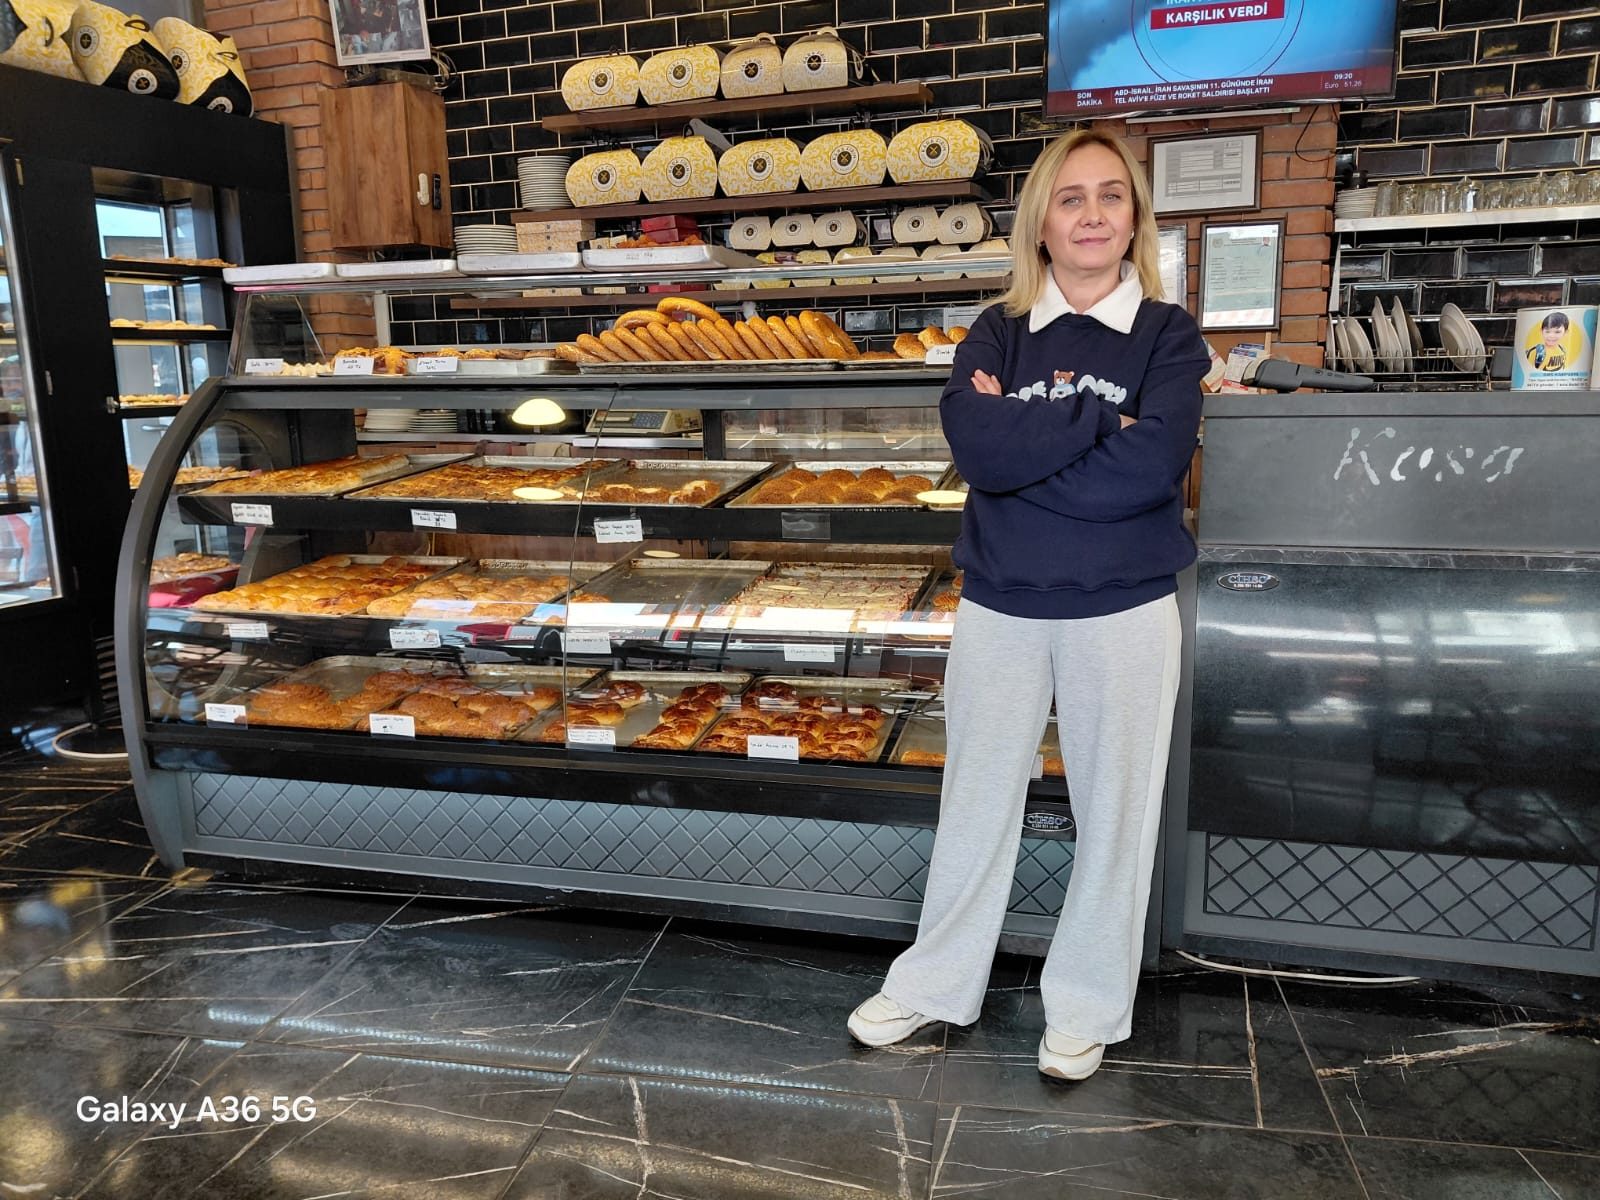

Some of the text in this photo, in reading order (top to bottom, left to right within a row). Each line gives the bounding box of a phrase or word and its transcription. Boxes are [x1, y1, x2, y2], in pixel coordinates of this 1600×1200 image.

[1166, 2, 1268, 24] KARŞILIK VERDİ
[1155, 84, 1172, 93] İRAN
[1172, 82, 1209, 92] SAVAŞININ
[1210, 82, 1220, 90] 11.
[1221, 79, 1256, 88] GÜNÜNDE
[1256, 77, 1273, 86] İRAN
[1077, 91, 1092, 100] SON
[1077, 98, 1103, 107] DAKİKA
[1115, 97, 1126, 105] TEL
[1150, 92, 1166, 102] FÜZE
[1168, 92, 1177, 100] VE
[1178, 91, 1200, 99] ROKET
[1202, 88, 1236, 98] SALDIRISI
[1237, 86, 1270, 97] BAŞLATTI
